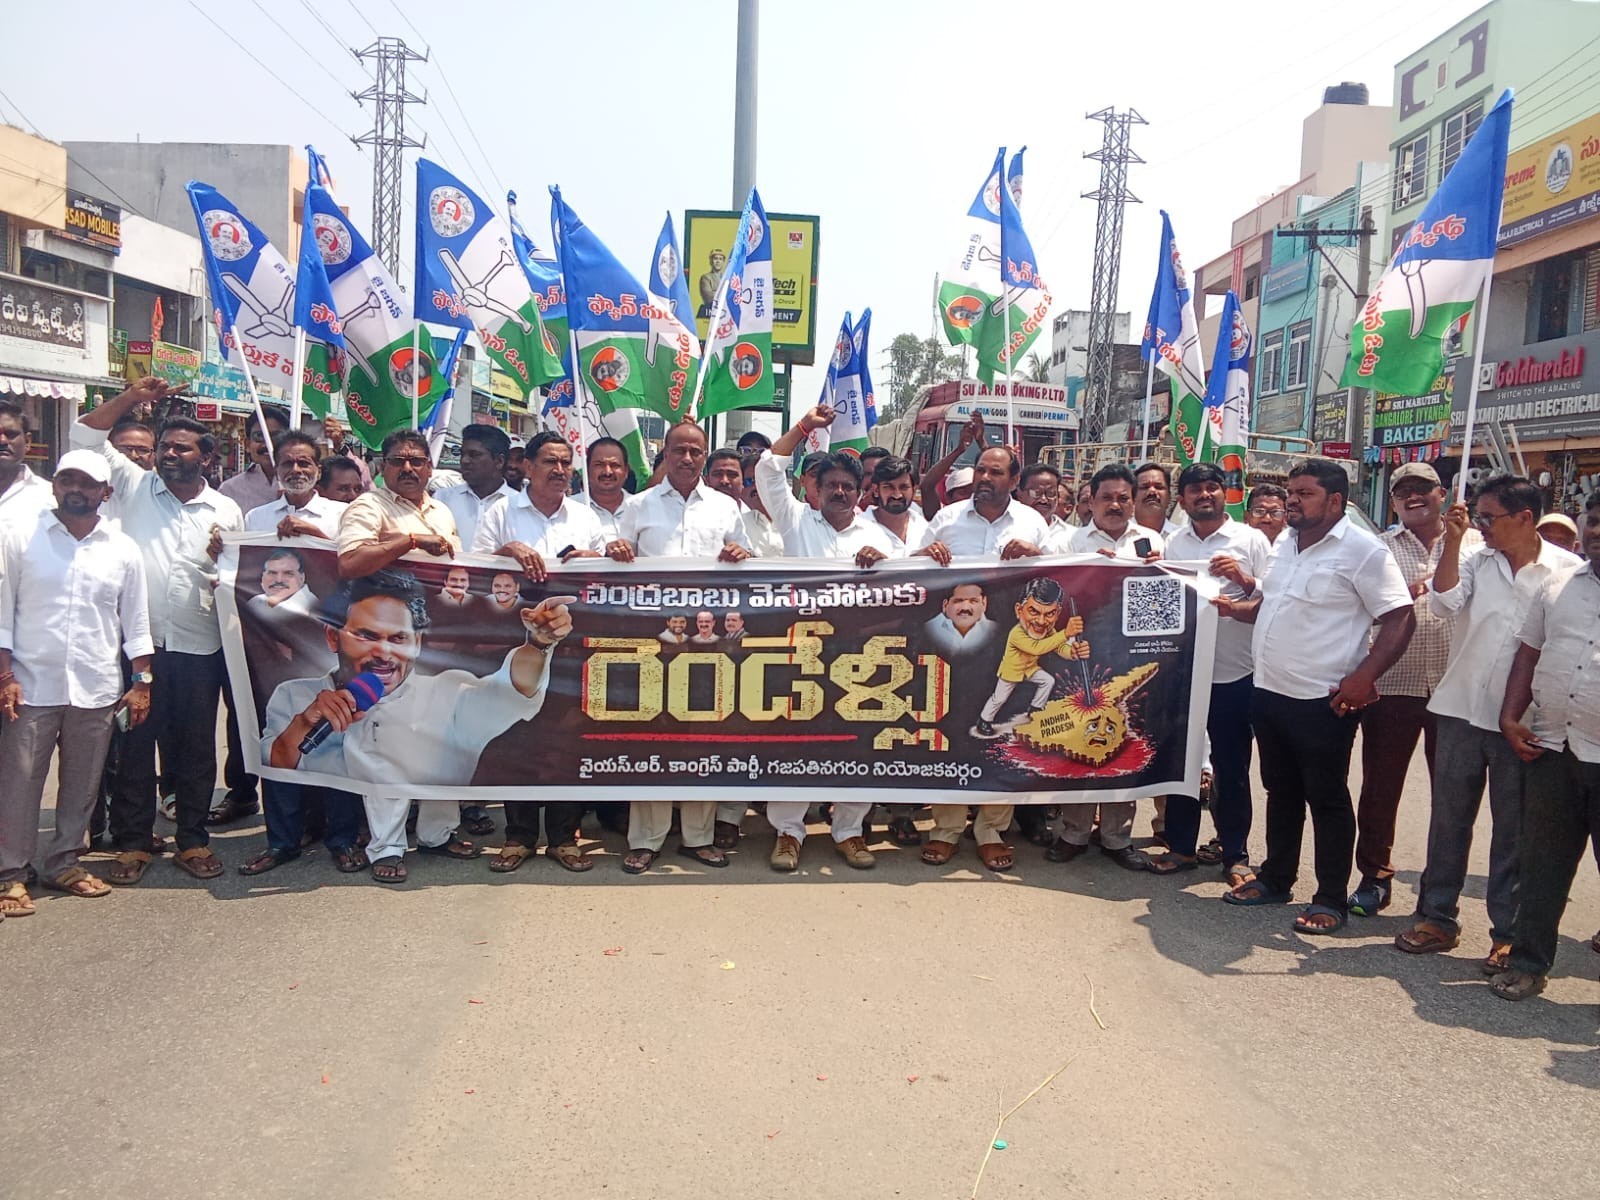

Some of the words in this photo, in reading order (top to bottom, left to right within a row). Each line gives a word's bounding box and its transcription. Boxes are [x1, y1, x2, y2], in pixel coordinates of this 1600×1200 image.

[88, 214, 121, 240] MOBILES
[587, 293, 637, 320] ఫ్యాన్
[1497, 345, 1585, 388] Goldmedal
[962, 383, 991, 397] SUA
[995, 382, 1041, 399] RODKING
[1393, 399, 1404, 410] SRI
[1406, 394, 1441, 407] MARUTHI
[1497, 390, 1521, 400] SWITCH
[1523, 388, 1532, 397] TO
[1534, 386, 1546, 394] THE
[1548, 381, 1582, 393] AMAZING
[957, 406, 970, 415] ALL
[1020, 410, 1042, 420] CARRIER
[1043, 411, 1070, 421] PERMIT
[1450, 410, 1465, 427] SRI
[1497, 401, 1534, 422] BALAJI
[1383, 421, 1447, 444] BAKERY
[580, 582, 740, 611] చంద్రబాబు
[748, 582, 928, 616] వెన్నుపోటుకు
[581, 620, 951, 752] రెండేళ్లు
[1040, 712, 1071, 729] ANDHRA
[1040, 721, 1075, 738] PRADESH
[668, 755, 723, 776] కాంగ్రెస్
[726, 754, 763, 780] పార్టీ,
[767, 758, 869, 776] గజపతినగరం
[872, 760, 983, 786] నియోజకవర్గం
